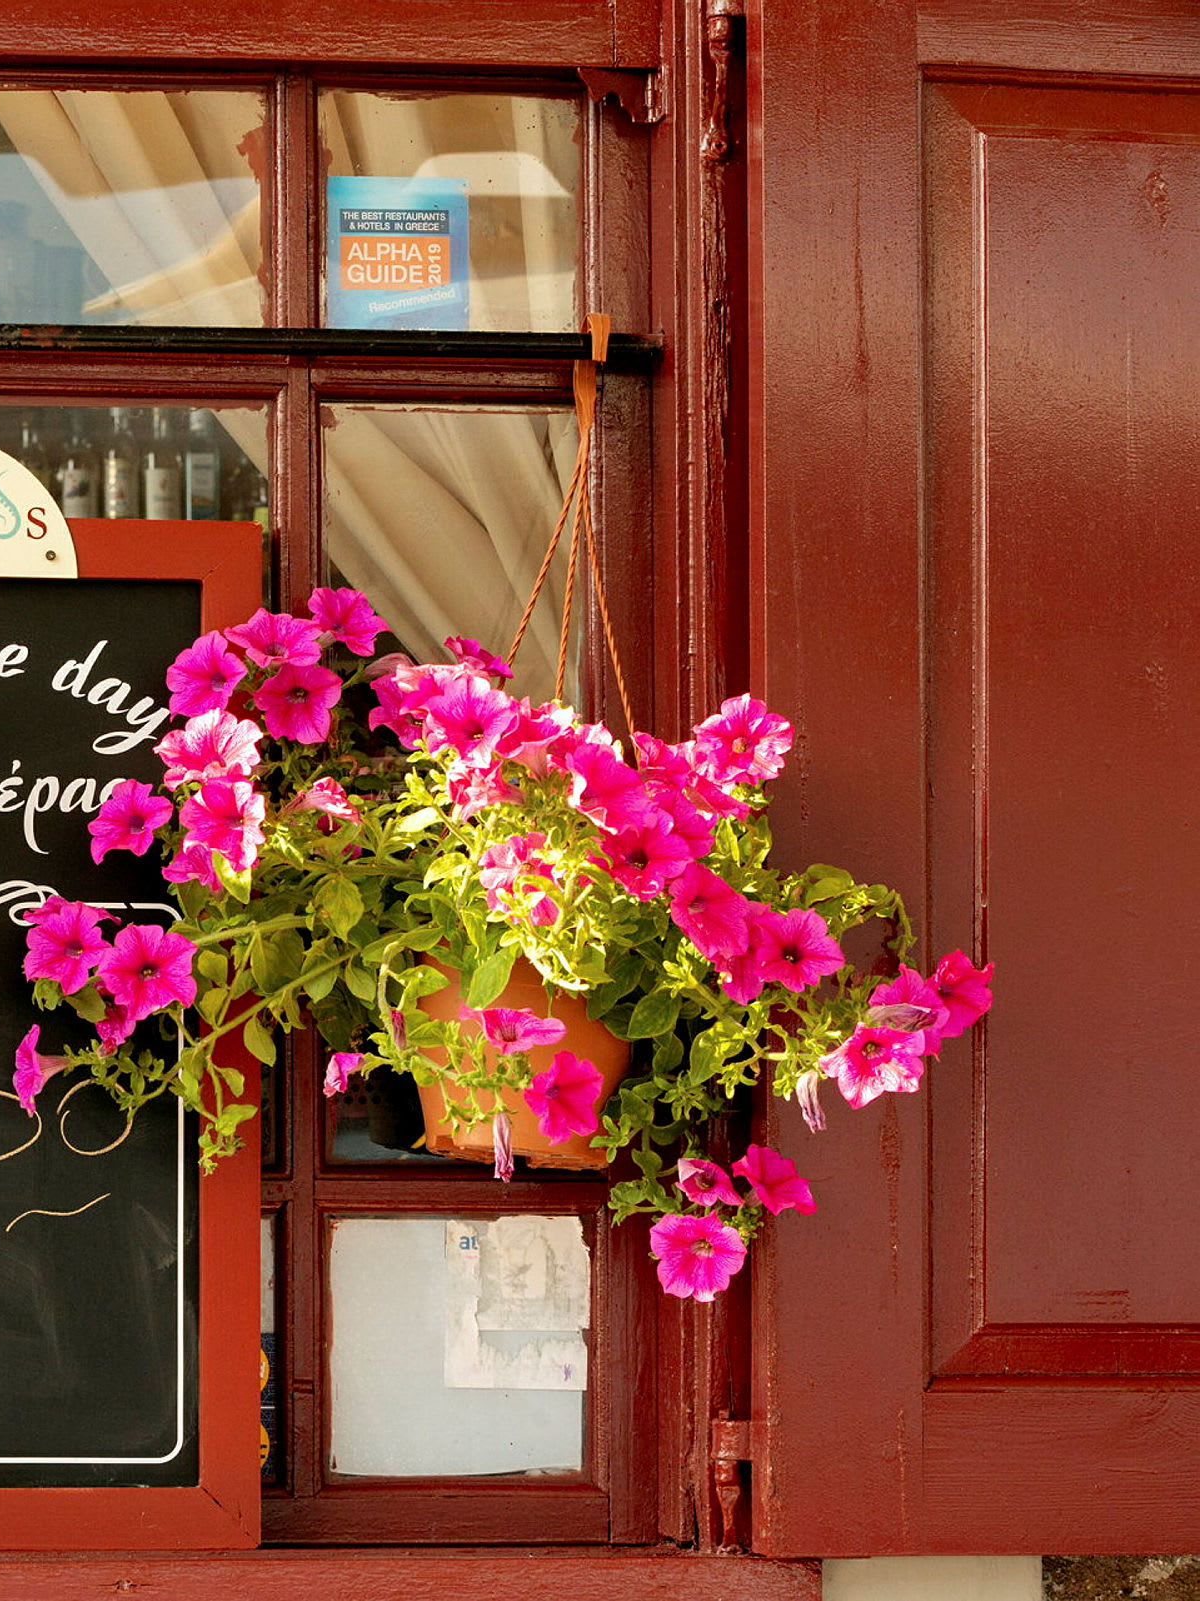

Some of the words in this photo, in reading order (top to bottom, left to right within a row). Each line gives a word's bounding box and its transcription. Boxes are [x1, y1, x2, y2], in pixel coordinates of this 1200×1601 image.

[342, 211, 360, 220] THE
[361, 211, 383, 220] BEST
[385, 211, 446, 221] RESTAURANTS
[405, 223, 440, 231] GREECE
[347, 242, 423, 262] ALPHA
[427, 243, 442, 284] 2019
[346, 264, 423, 284] GUIDE
[368, 287, 456, 313] Recommended
[51, 640, 170, 755] day
